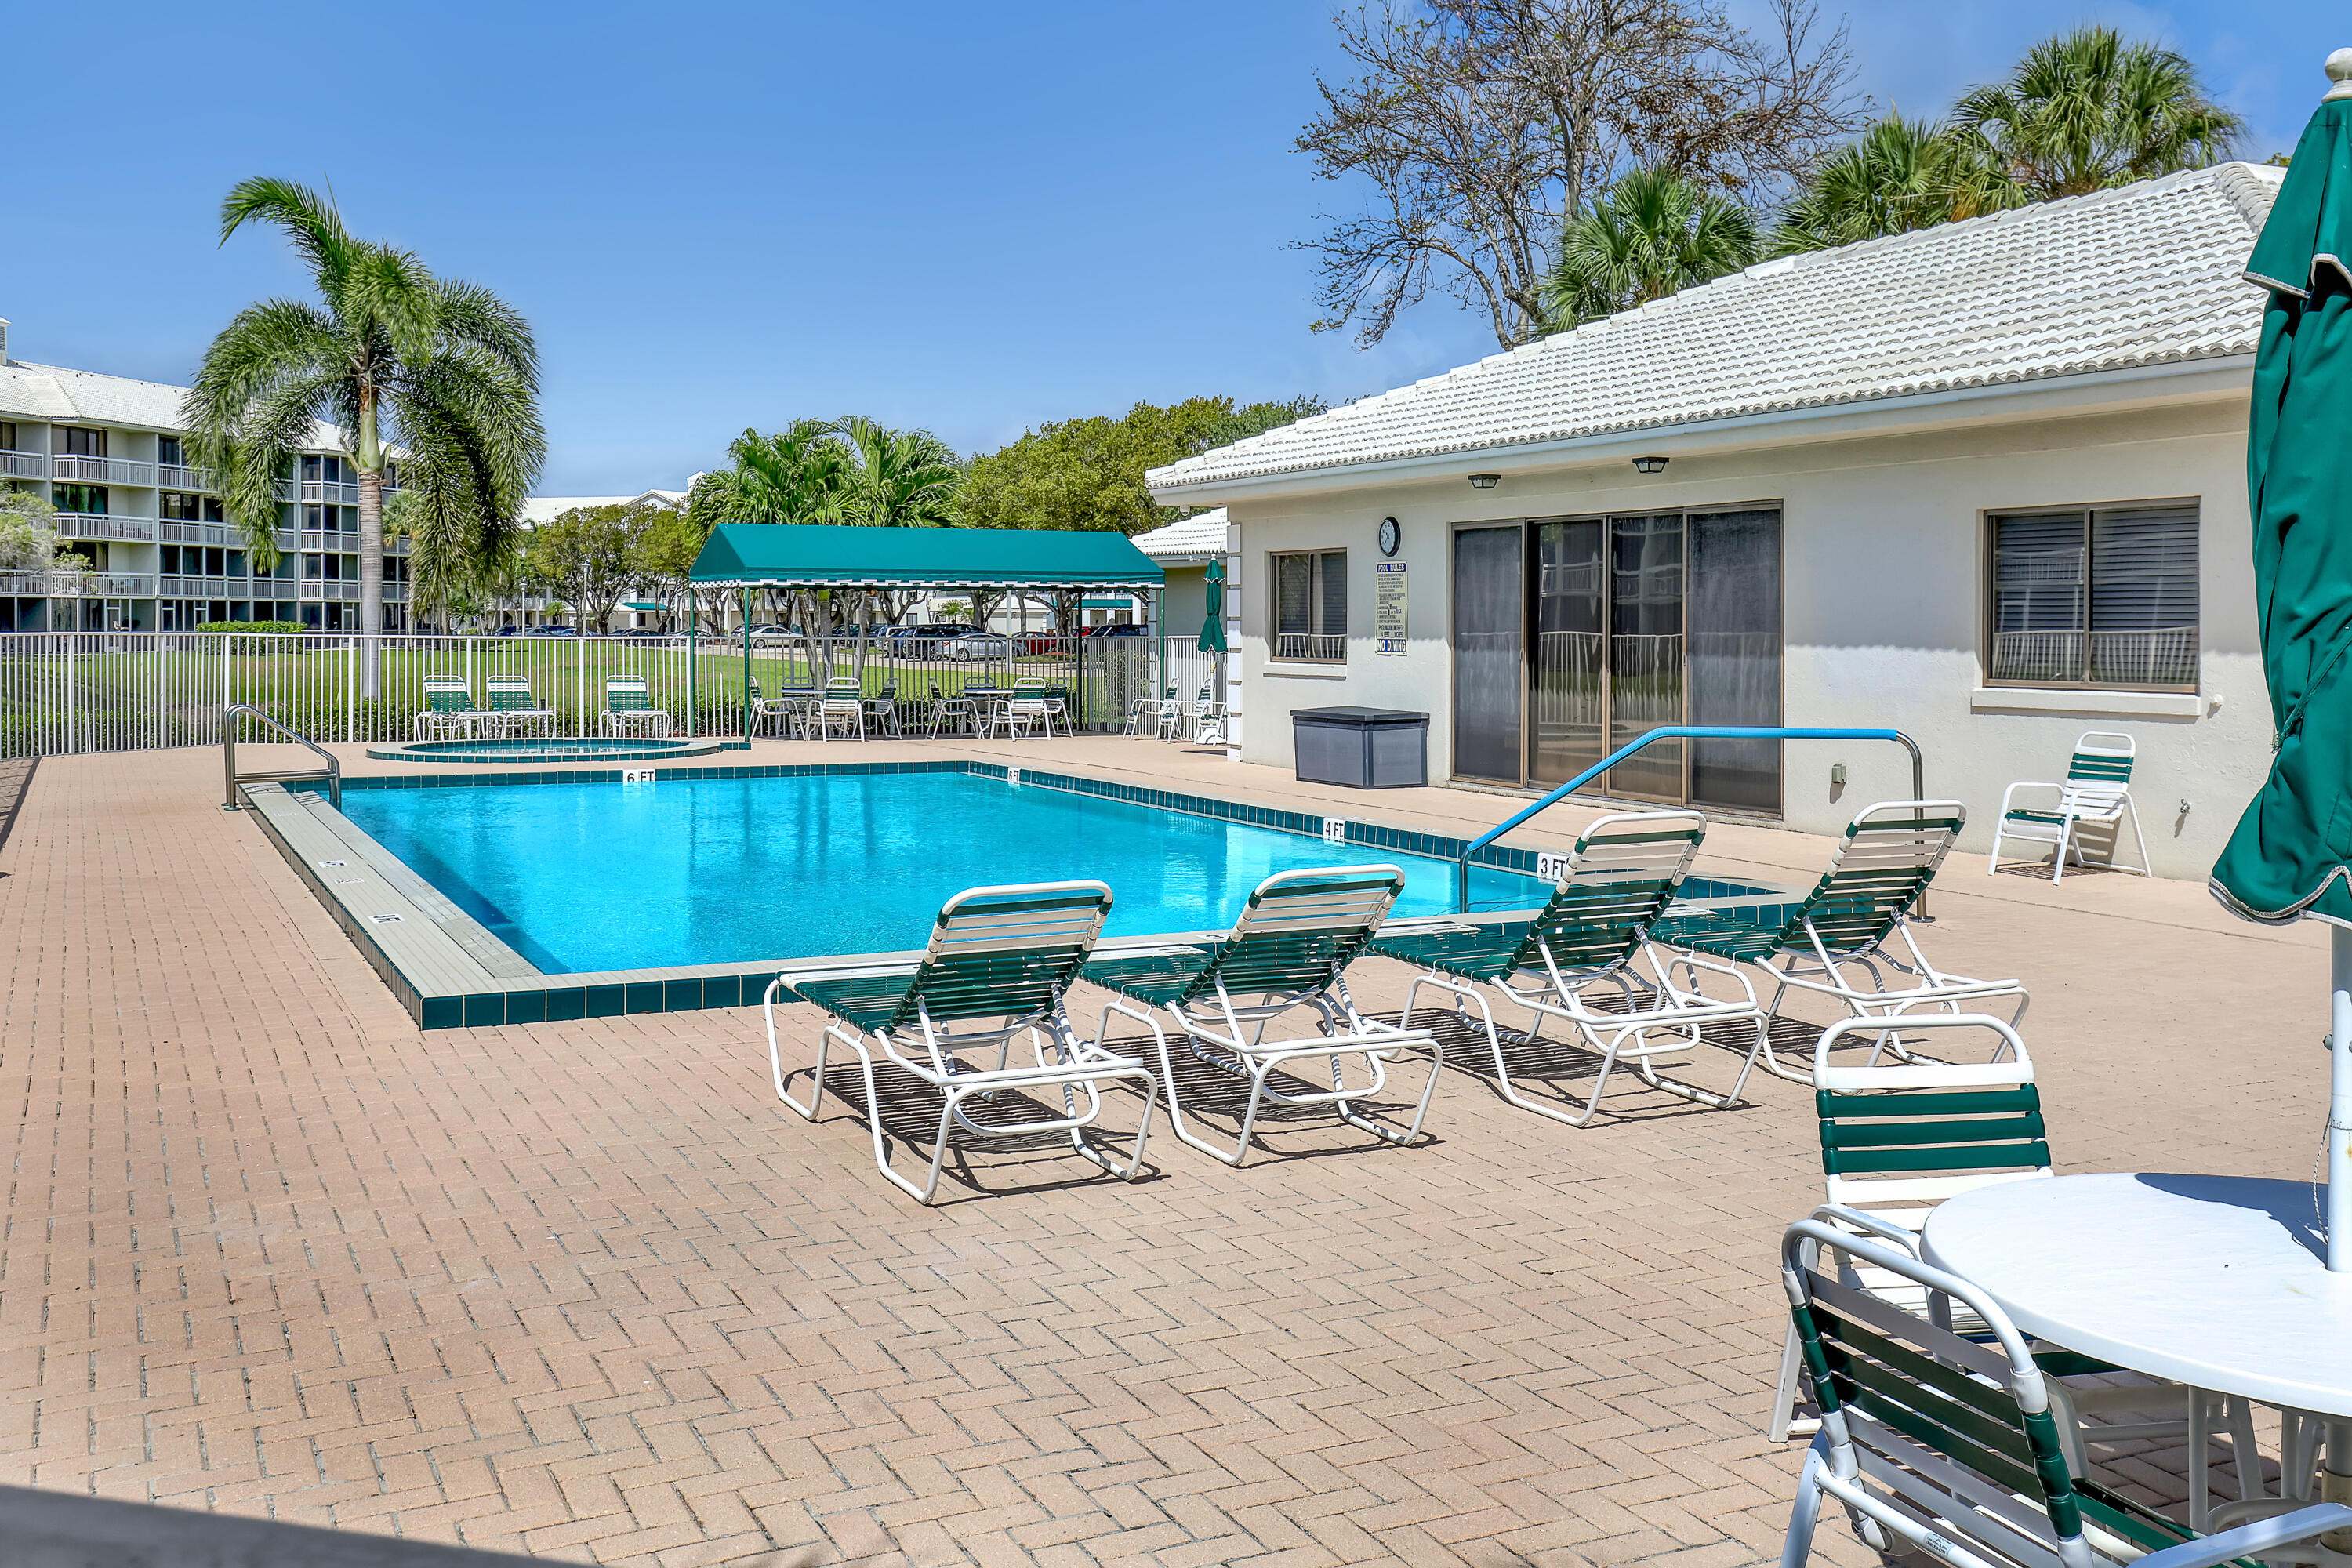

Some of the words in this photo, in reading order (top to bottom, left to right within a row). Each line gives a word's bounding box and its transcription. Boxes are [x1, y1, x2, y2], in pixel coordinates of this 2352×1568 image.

[1377, 640, 1385, 651] NO
[1388, 640, 1406, 652] DIVING
[627, 772, 635, 782] 6
[641, 771, 654, 782] FT
[1326, 821, 1330, 837] 4
[1541, 858, 1548, 874] 3
[1552, 858, 1566, 877] FT
